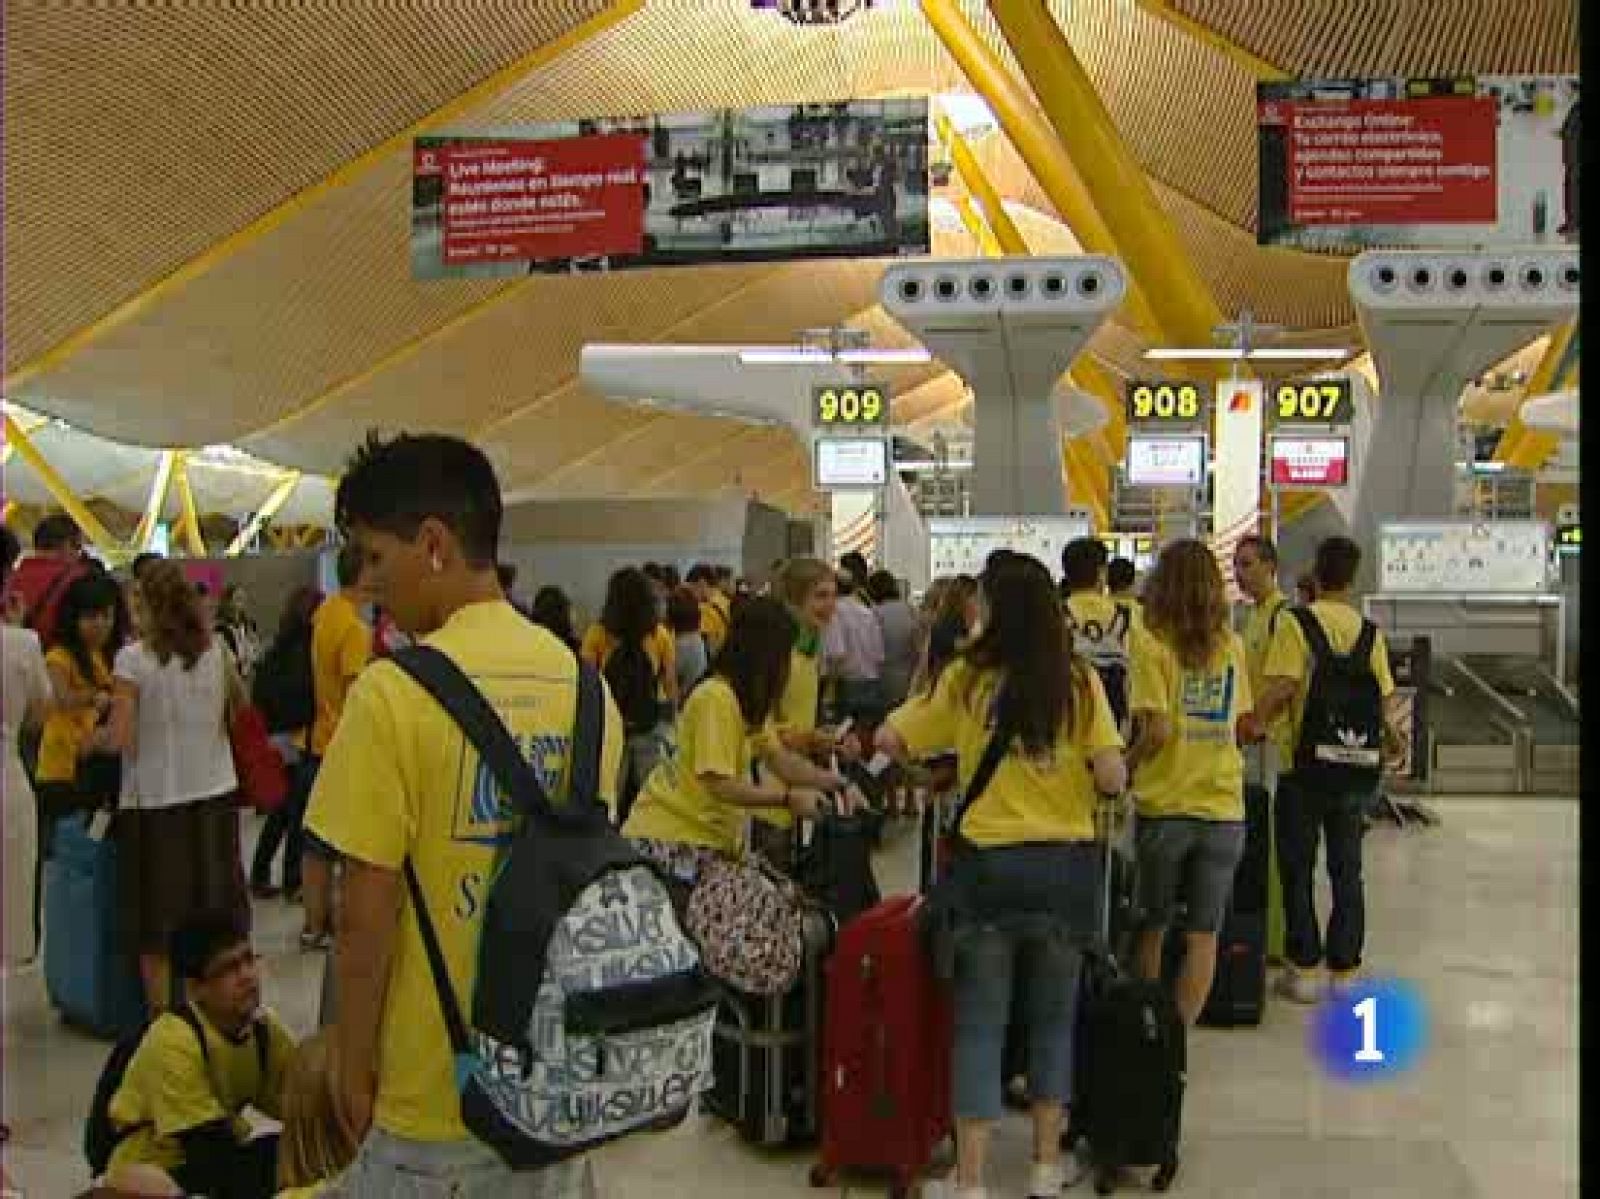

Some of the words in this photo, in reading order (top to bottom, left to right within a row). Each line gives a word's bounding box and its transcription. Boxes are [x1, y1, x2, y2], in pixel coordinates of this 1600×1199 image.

[819, 389, 881, 421] 909
[1133, 386, 1199, 417] 908
[1279, 386, 1341, 417] 907
